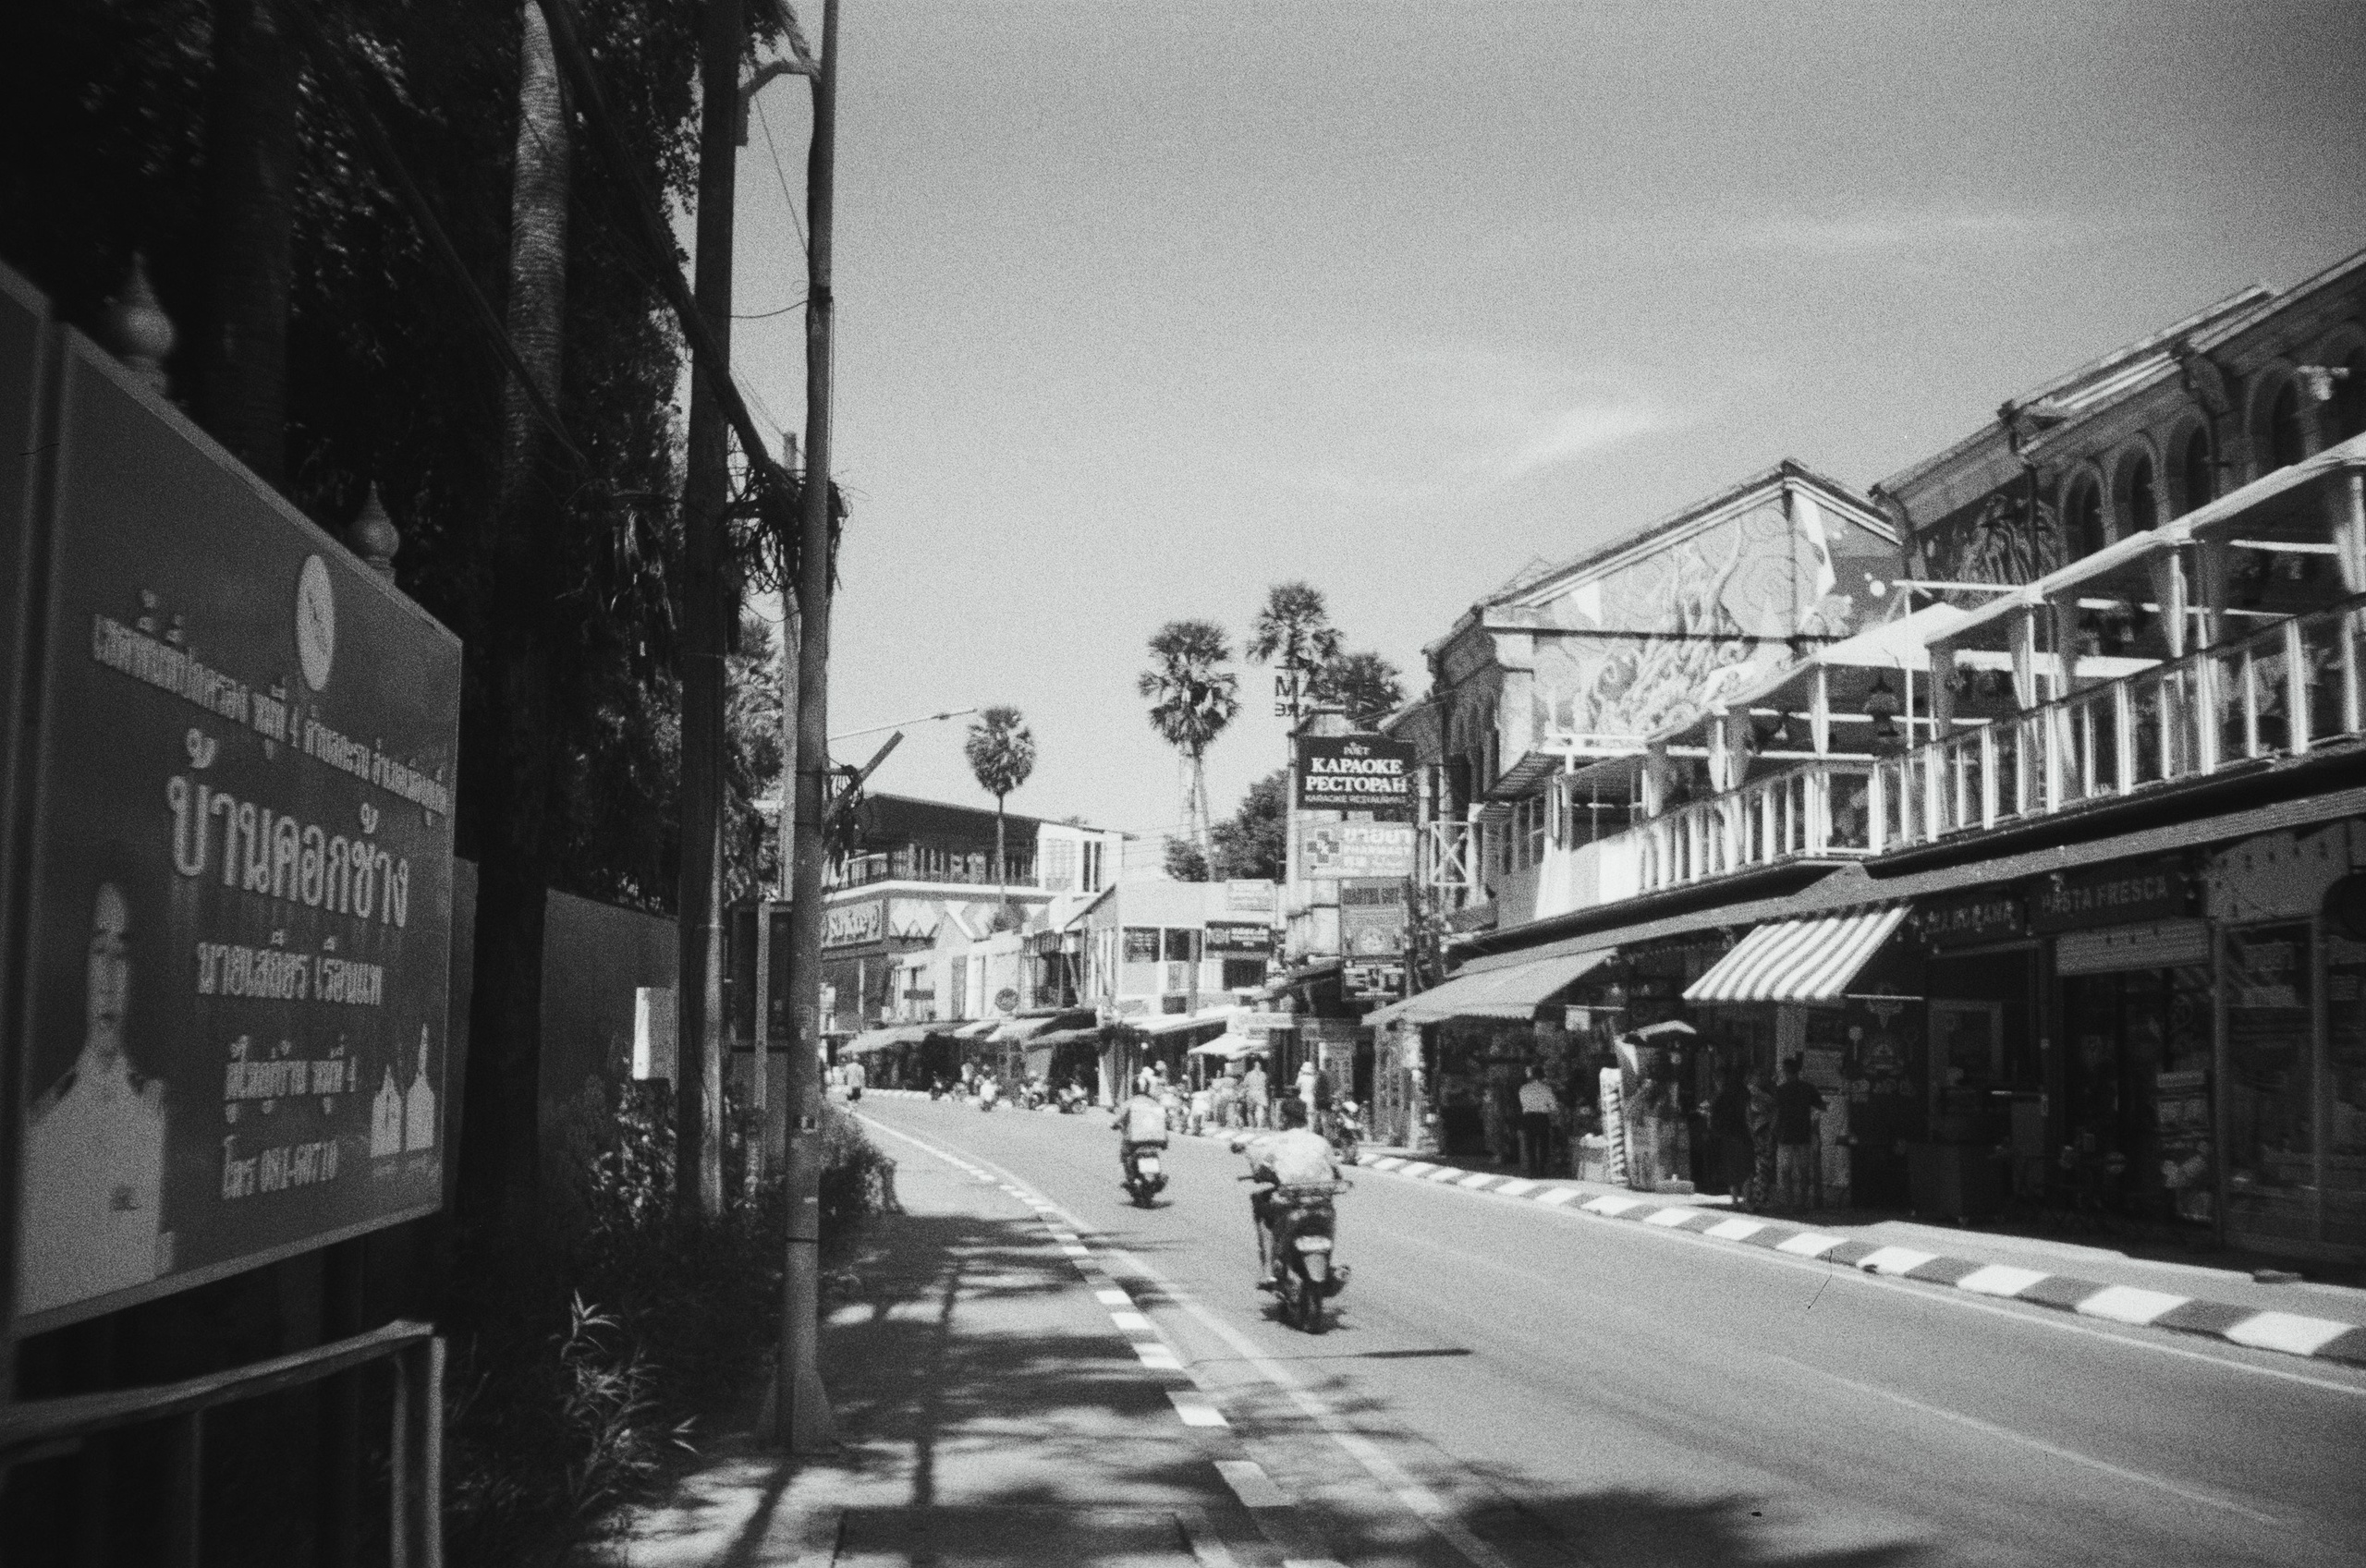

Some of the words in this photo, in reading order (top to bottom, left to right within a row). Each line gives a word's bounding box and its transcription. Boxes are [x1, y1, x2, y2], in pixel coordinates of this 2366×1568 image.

[1311, 757, 1404, 774] КАРАОКЕ
[1304, 775, 1408, 793] РЕСТОРАН
[165, 726, 410, 929] บ้านคอกช้าง
[2100, 873, 2169, 907] FRESCA
[346, 1055, 359, 1093] 4
